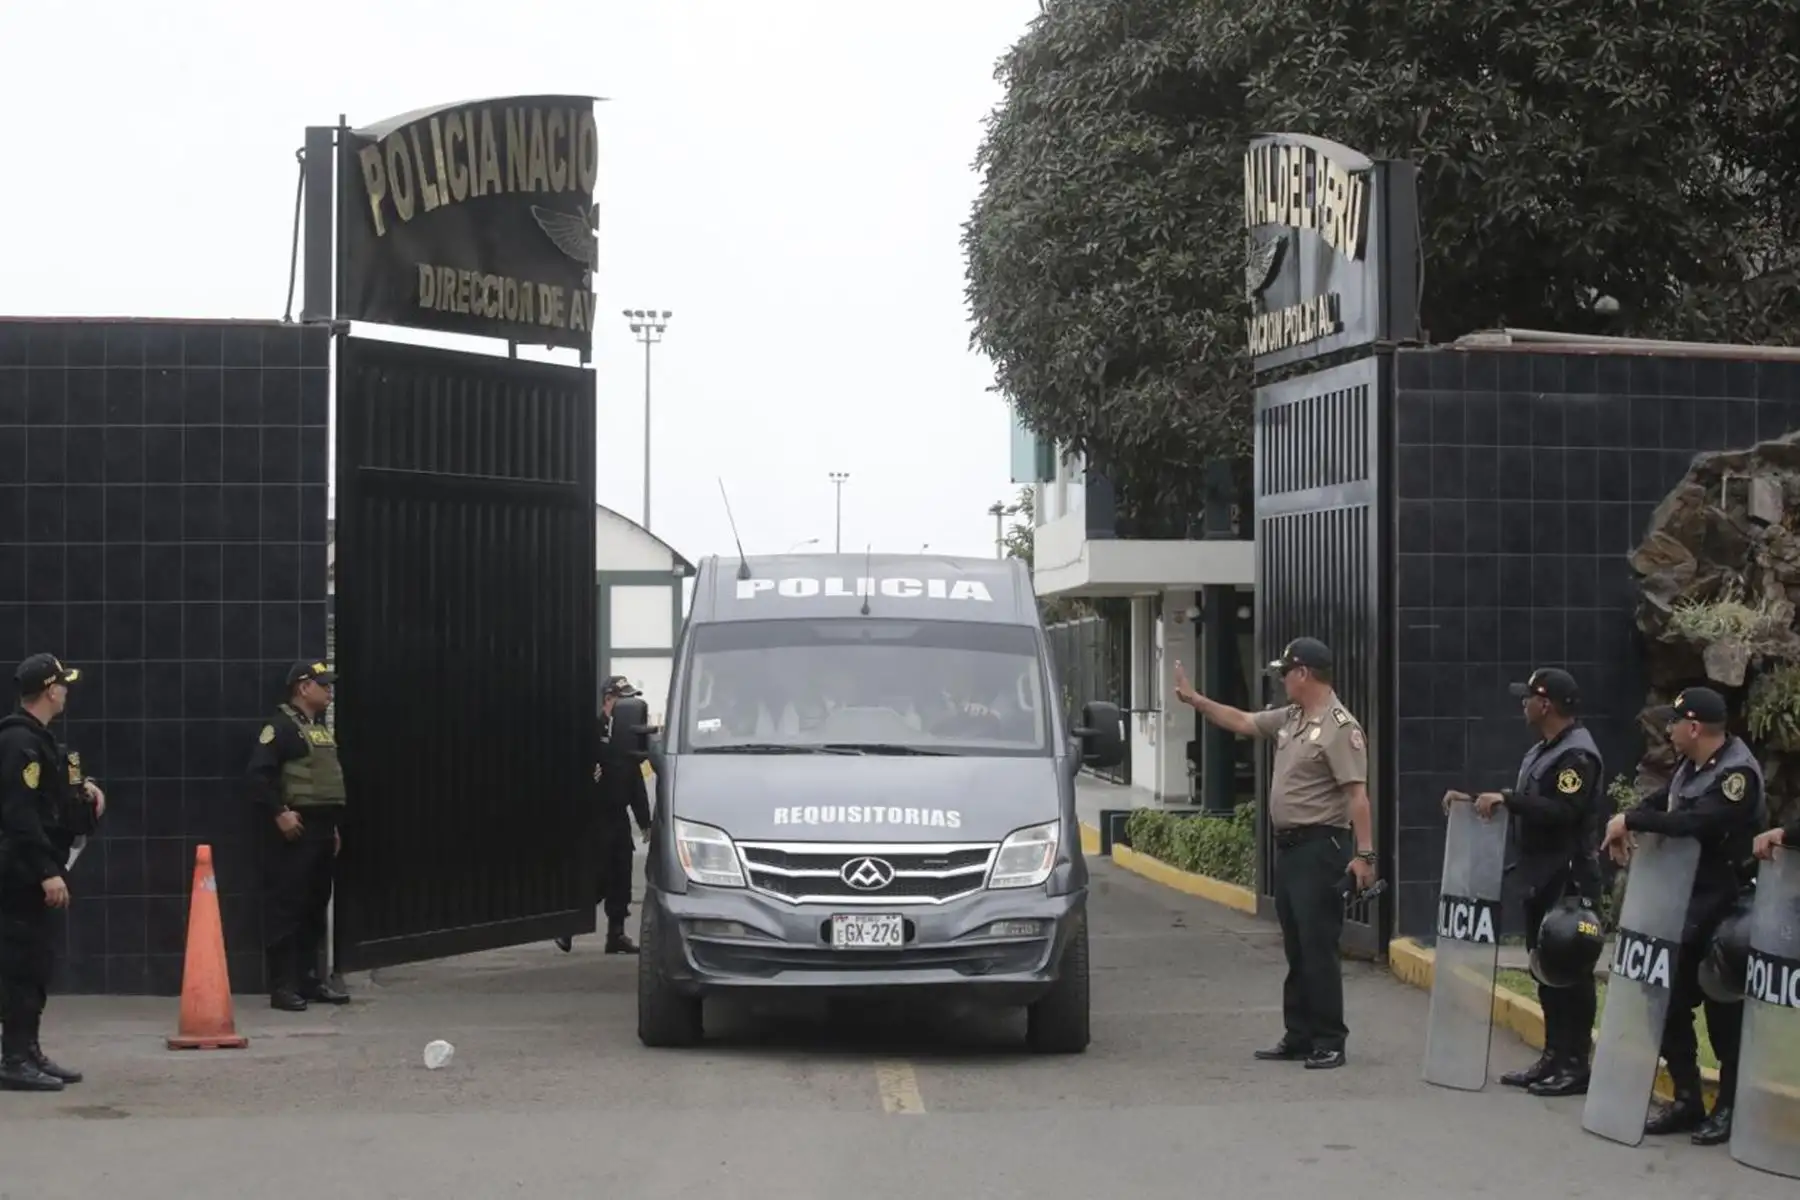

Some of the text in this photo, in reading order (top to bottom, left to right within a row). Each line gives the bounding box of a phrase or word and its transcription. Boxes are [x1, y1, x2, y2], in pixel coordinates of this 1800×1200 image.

[359, 108, 502, 237] POLICIA
[1278, 146, 1311, 228] DEL
[419, 263, 533, 324] DIRECCION
[538, 283, 564, 328] DE
[736, 577, 994, 602] POLICIA
[774, 805, 962, 828] REQUISITORIAS
